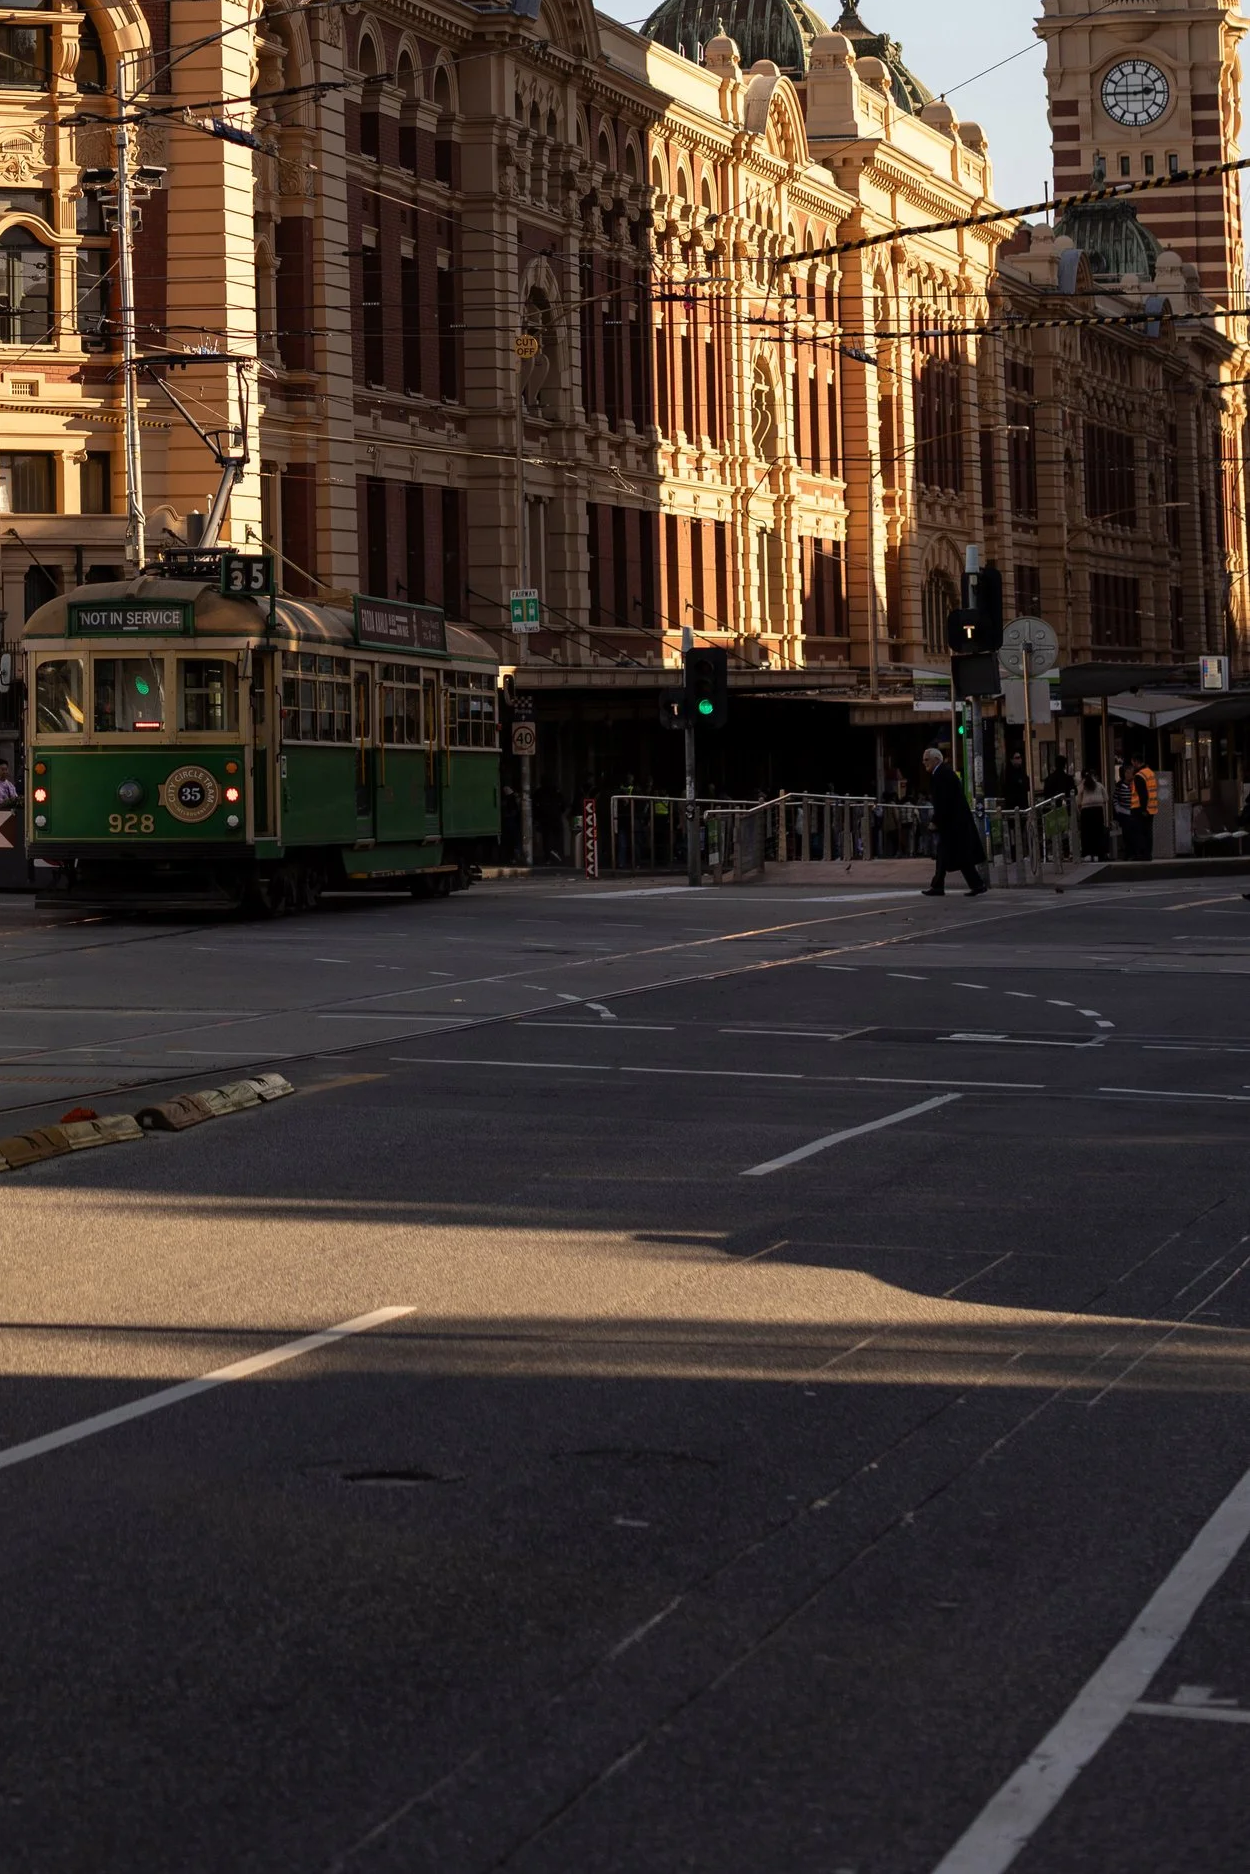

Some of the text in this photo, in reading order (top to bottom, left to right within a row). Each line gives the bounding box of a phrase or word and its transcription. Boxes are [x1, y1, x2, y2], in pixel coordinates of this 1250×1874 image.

[516, 338, 535, 346] CUT
[80, 611, 181, 625] NOT IN SERVICE
[516, 732, 532, 744] 40
[174, 769, 204, 782] CIRCLE
[203, 777, 215, 803] TRAM
[181, 787, 201, 801] 35
[109, 813, 155, 834] 928
